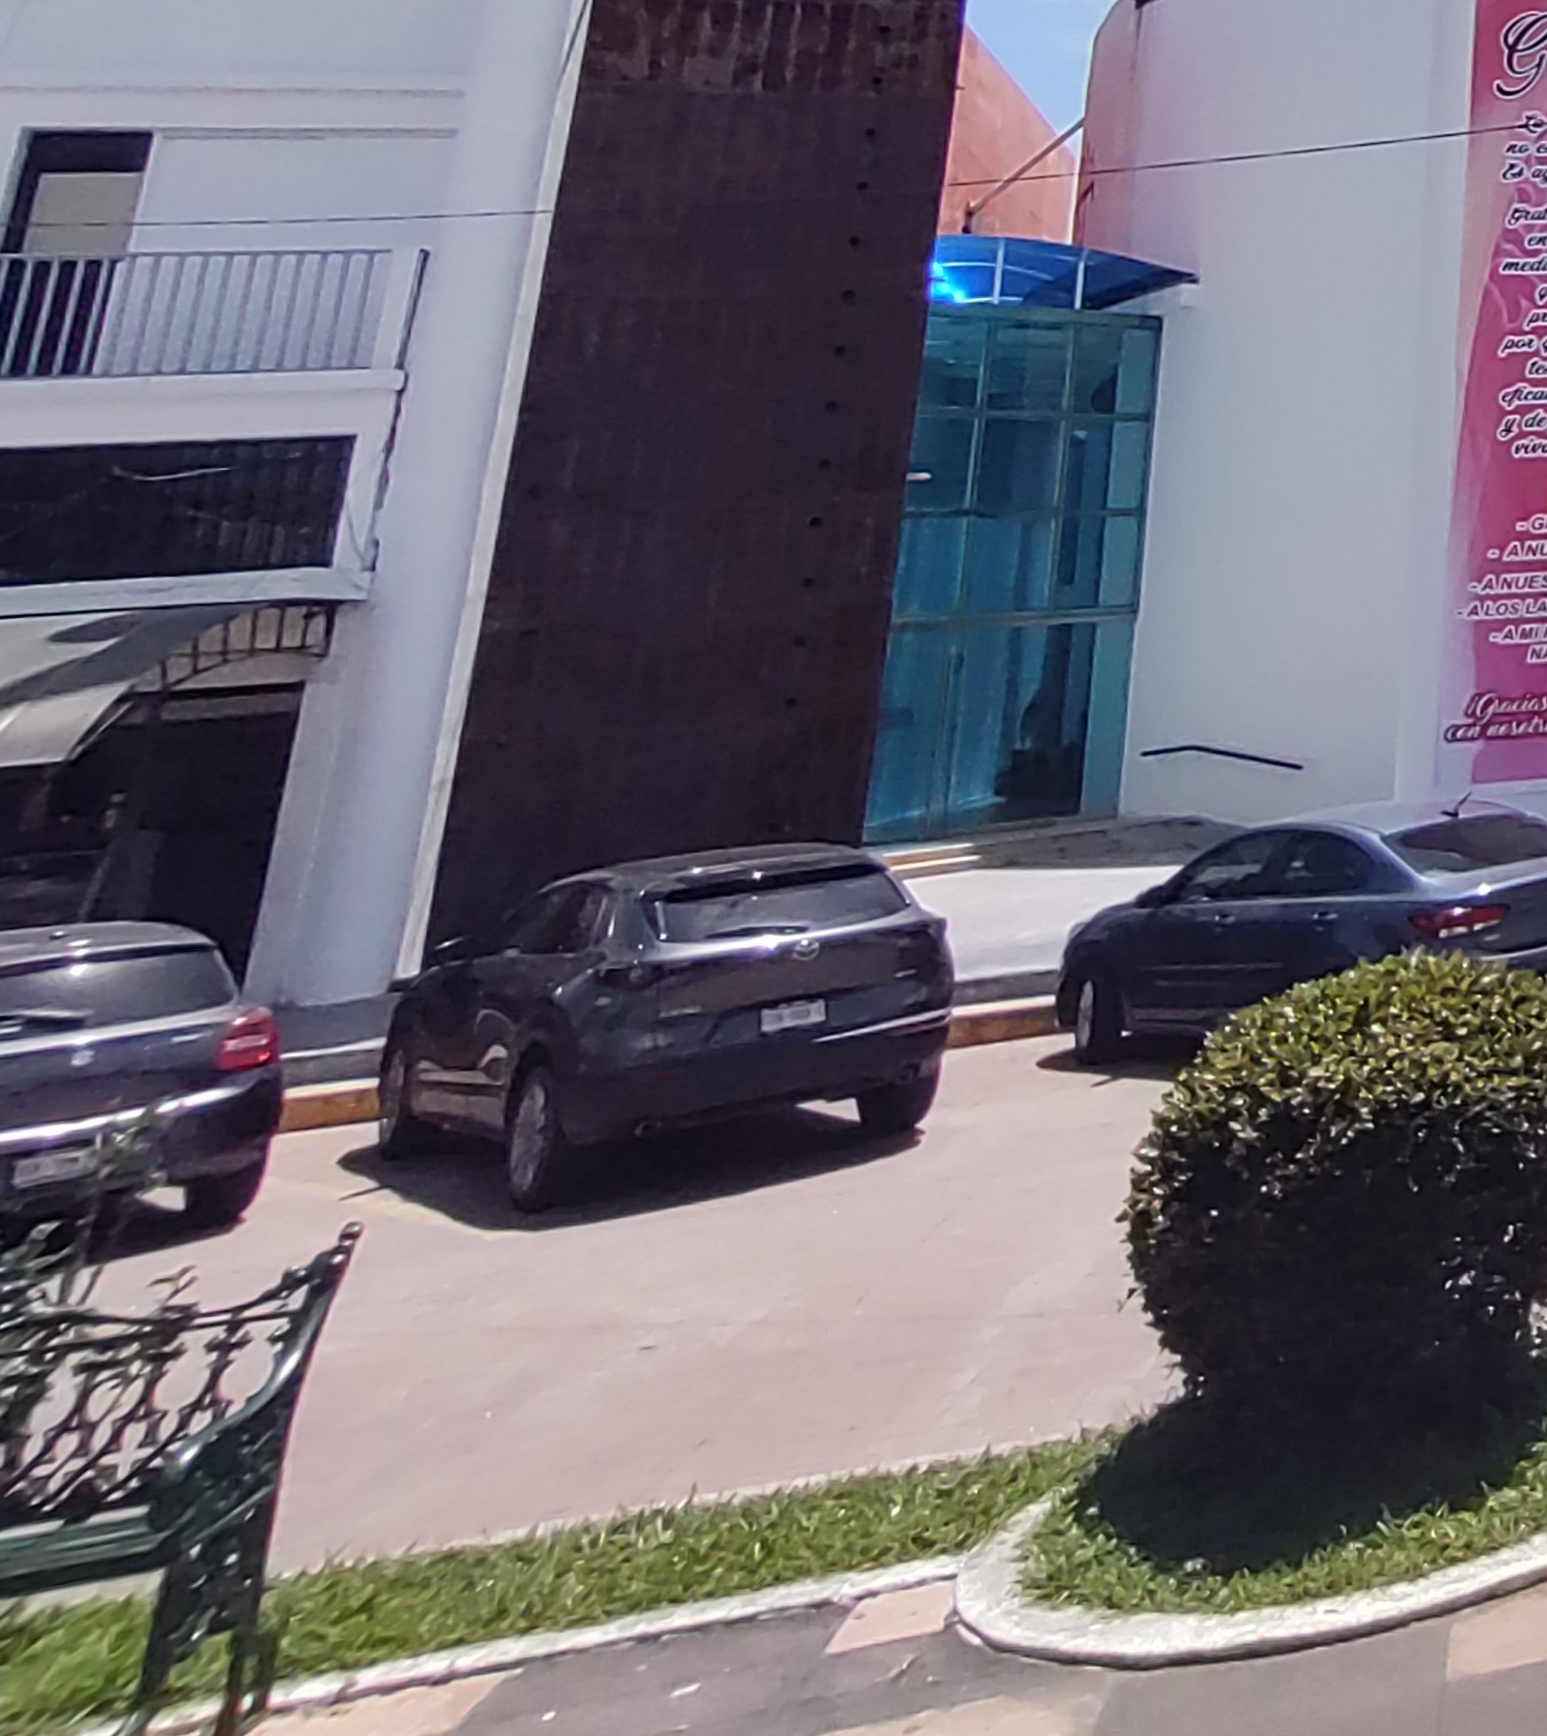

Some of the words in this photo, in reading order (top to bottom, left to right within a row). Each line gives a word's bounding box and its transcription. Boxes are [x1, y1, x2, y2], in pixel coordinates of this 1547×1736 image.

[1506, 144, 1529, 153] no
[1503, 163, 1524, 178] Es
[1528, 234, 1547, 245] en
[1500, 337, 1534, 355] por
[1500, 417, 1516, 438] y
[1524, 414, 1547, 428] de
[1506, 544, 1519, 558] A
[1482, 577, 1495, 591] A
[1468, 603, 1480, 616] A
[1484, 601, 1519, 615] LOS
[1502, 627, 1517, 641] A
[1519, 627, 1538, 640] MI
[1447, 724, 1480, 740] con
